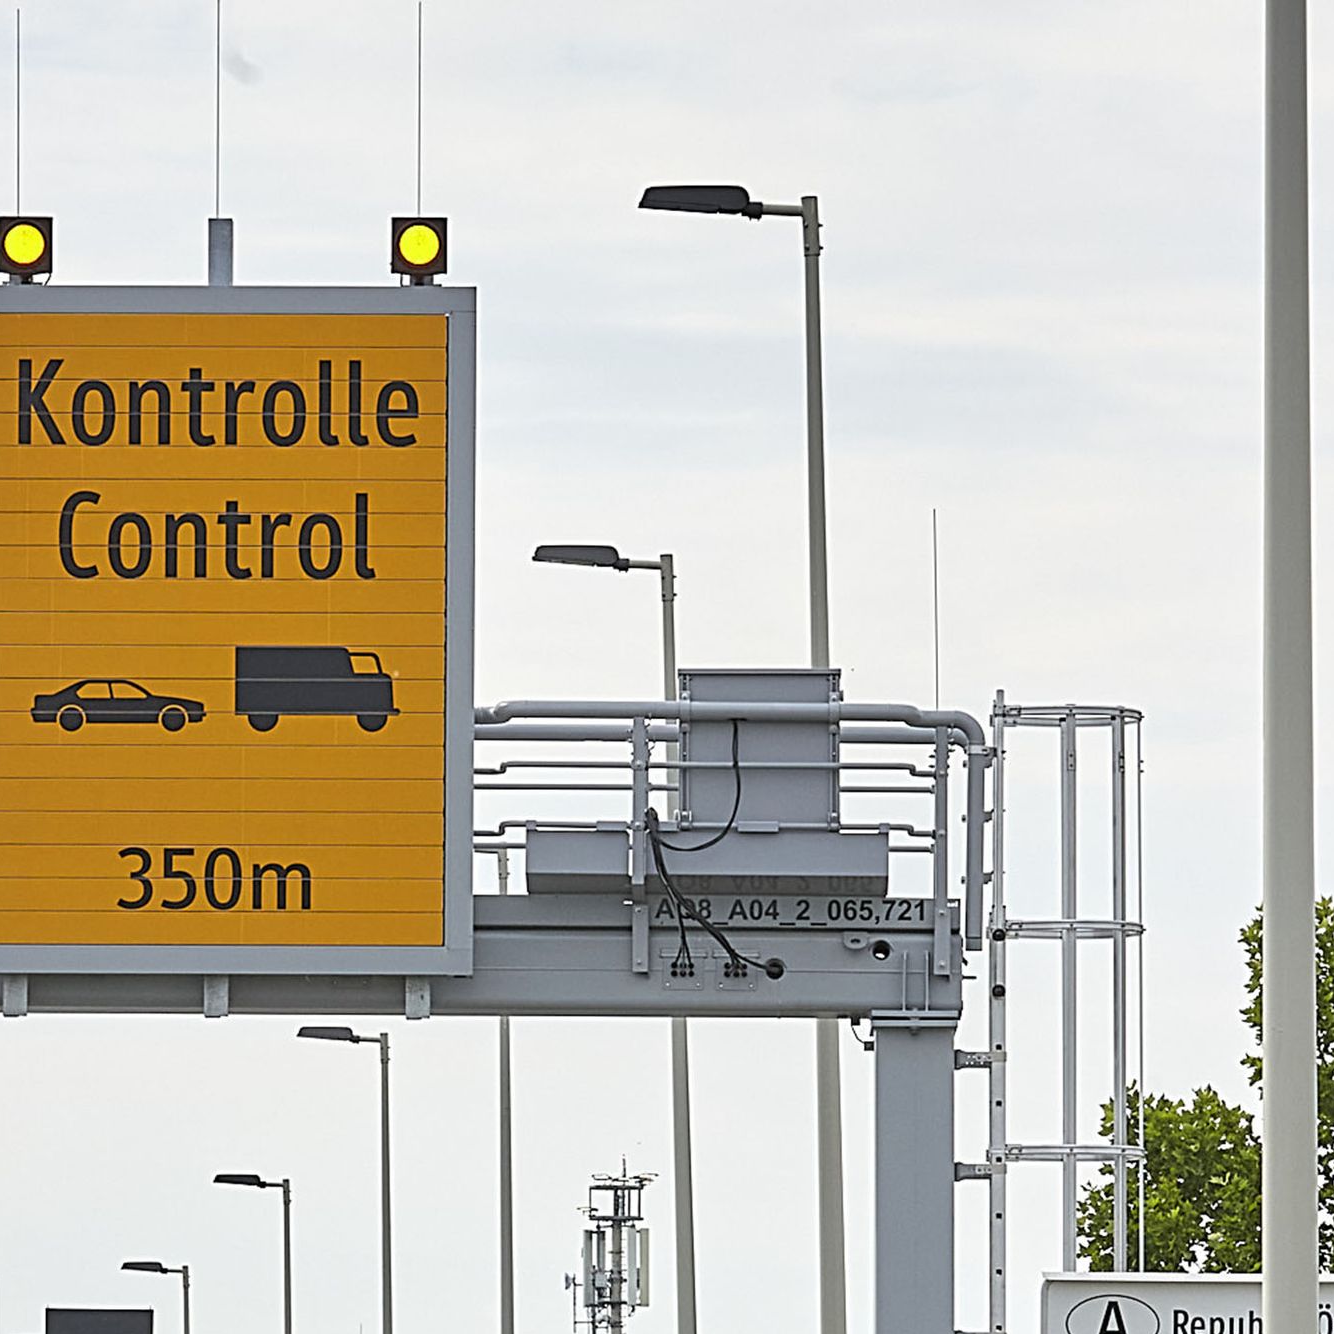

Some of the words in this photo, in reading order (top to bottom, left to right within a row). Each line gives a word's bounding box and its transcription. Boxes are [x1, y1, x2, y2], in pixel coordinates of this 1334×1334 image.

[16, 357, 419, 446] Kontrolle
[58, 490, 376, 580] Control
[116, 846, 313, 910] 350m
